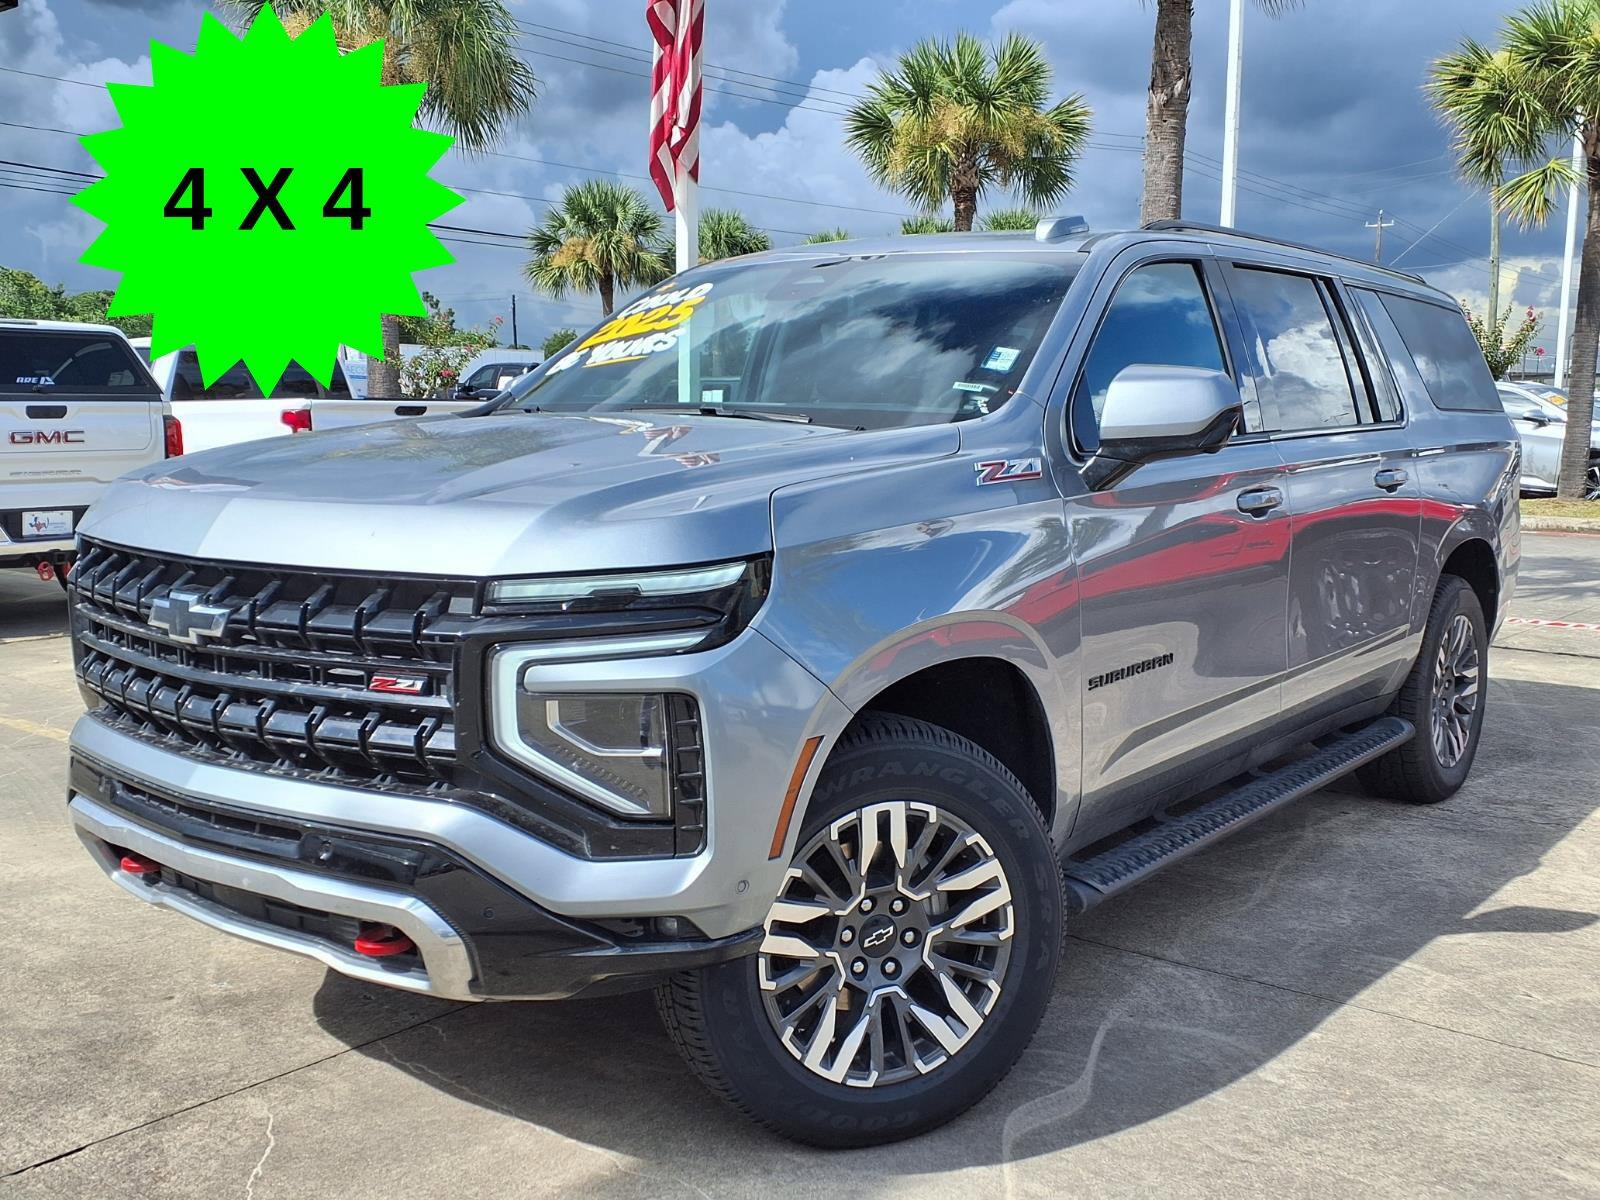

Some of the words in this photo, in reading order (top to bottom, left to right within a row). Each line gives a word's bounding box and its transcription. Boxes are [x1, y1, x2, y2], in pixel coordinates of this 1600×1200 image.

[10, 430, 86, 445] GMC
[974, 458, 1043, 486] Z71
[368, 675, 425, 694] Z71
[1088, 652, 1174, 691] SUBURBAN
[815, 760, 1032, 840] WRANGLER
